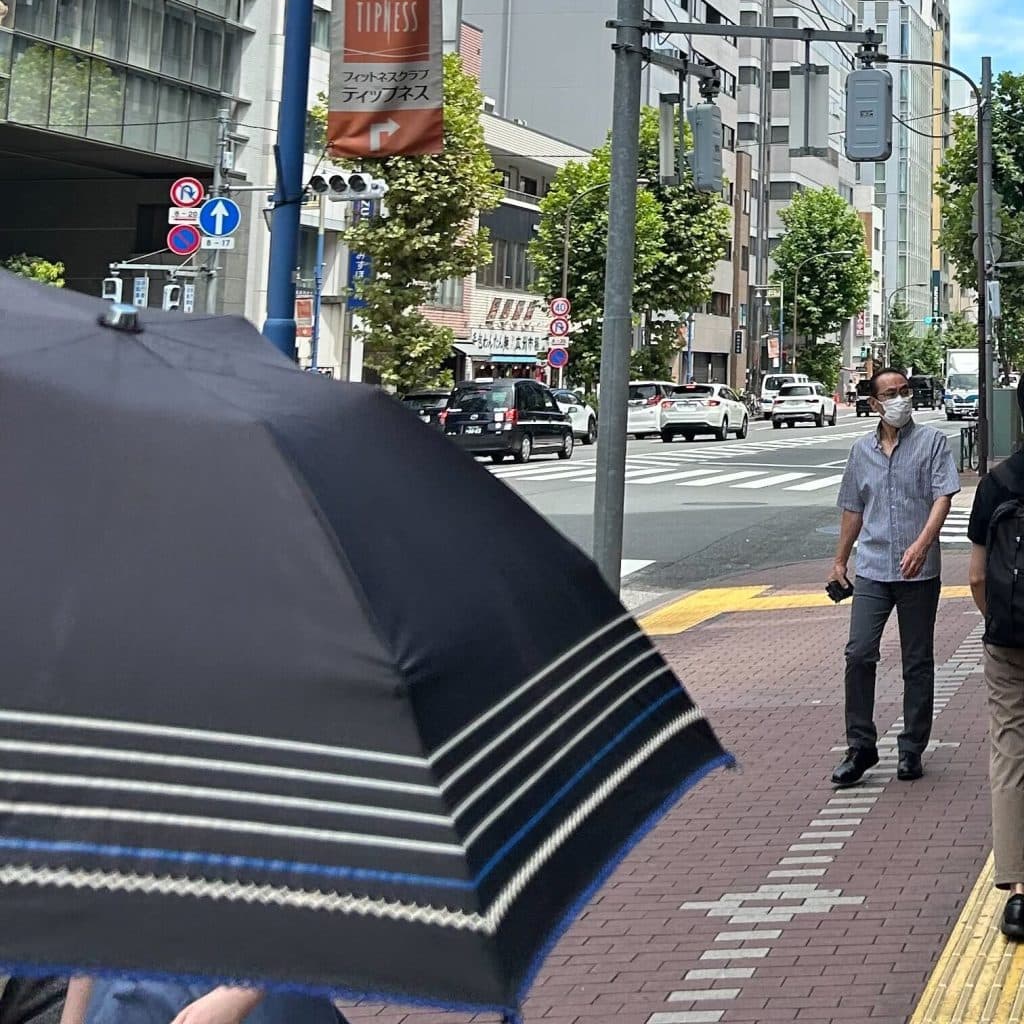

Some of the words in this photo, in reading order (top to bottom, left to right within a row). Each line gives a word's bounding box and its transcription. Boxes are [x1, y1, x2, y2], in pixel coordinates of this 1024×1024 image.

[343, 69, 430, 83] フィットネスクラブ
[342, 84, 430, 104] ティップネス
